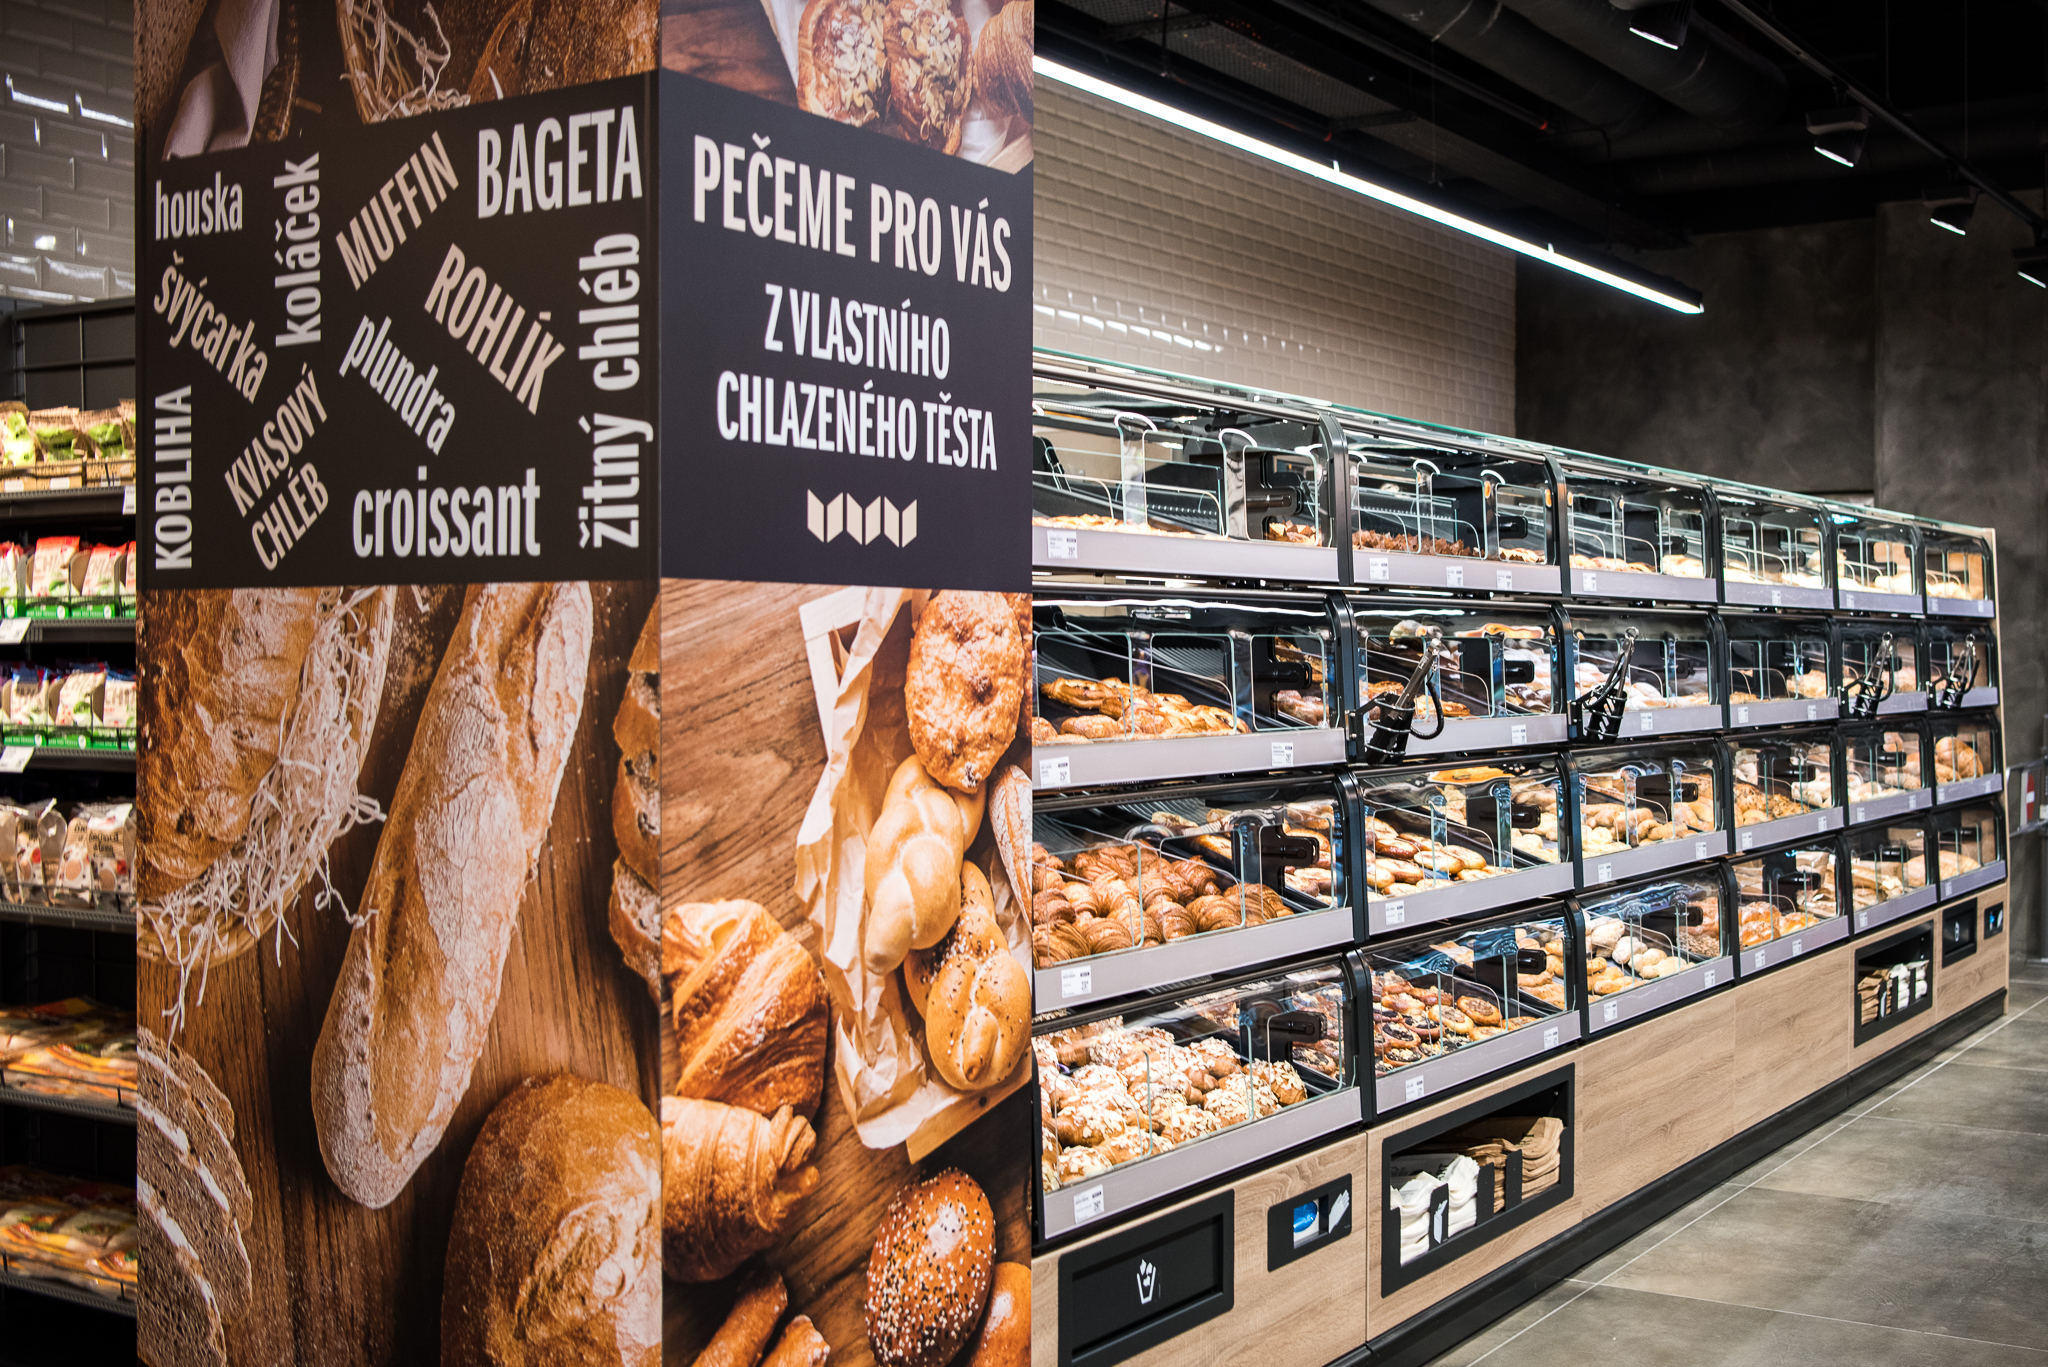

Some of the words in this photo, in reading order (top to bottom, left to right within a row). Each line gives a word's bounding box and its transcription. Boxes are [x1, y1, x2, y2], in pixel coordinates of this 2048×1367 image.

[155, 171, 243, 241] houska
[335, 131, 459, 291] MUFFIN
[478, 105, 643, 219] BAGETA
[694, 132, 856, 258] PEČEME
[870, 183, 942, 276] PRO
[950, 197, 1012, 292] VÁS
[273, 152, 322, 347] koláček
[578, 233, 641, 391] chléb
[338, 315, 456, 456] plundra
[424, 243, 566, 415] ROHLÍK
[764, 283, 784, 352] Z
[789, 287, 950, 380] VLASTNÍHO
[155, 385, 192, 570] KOBLIHA
[224, 362, 328, 517] KVASOVÝ
[578, 413, 654, 549] žitný
[717, 370, 918, 462] CHLAZENÉHO
[922, 391, 998, 471] TĚSTA
[251, 461, 329, 571] CHLÉB
[353, 466, 541, 557] croissant
